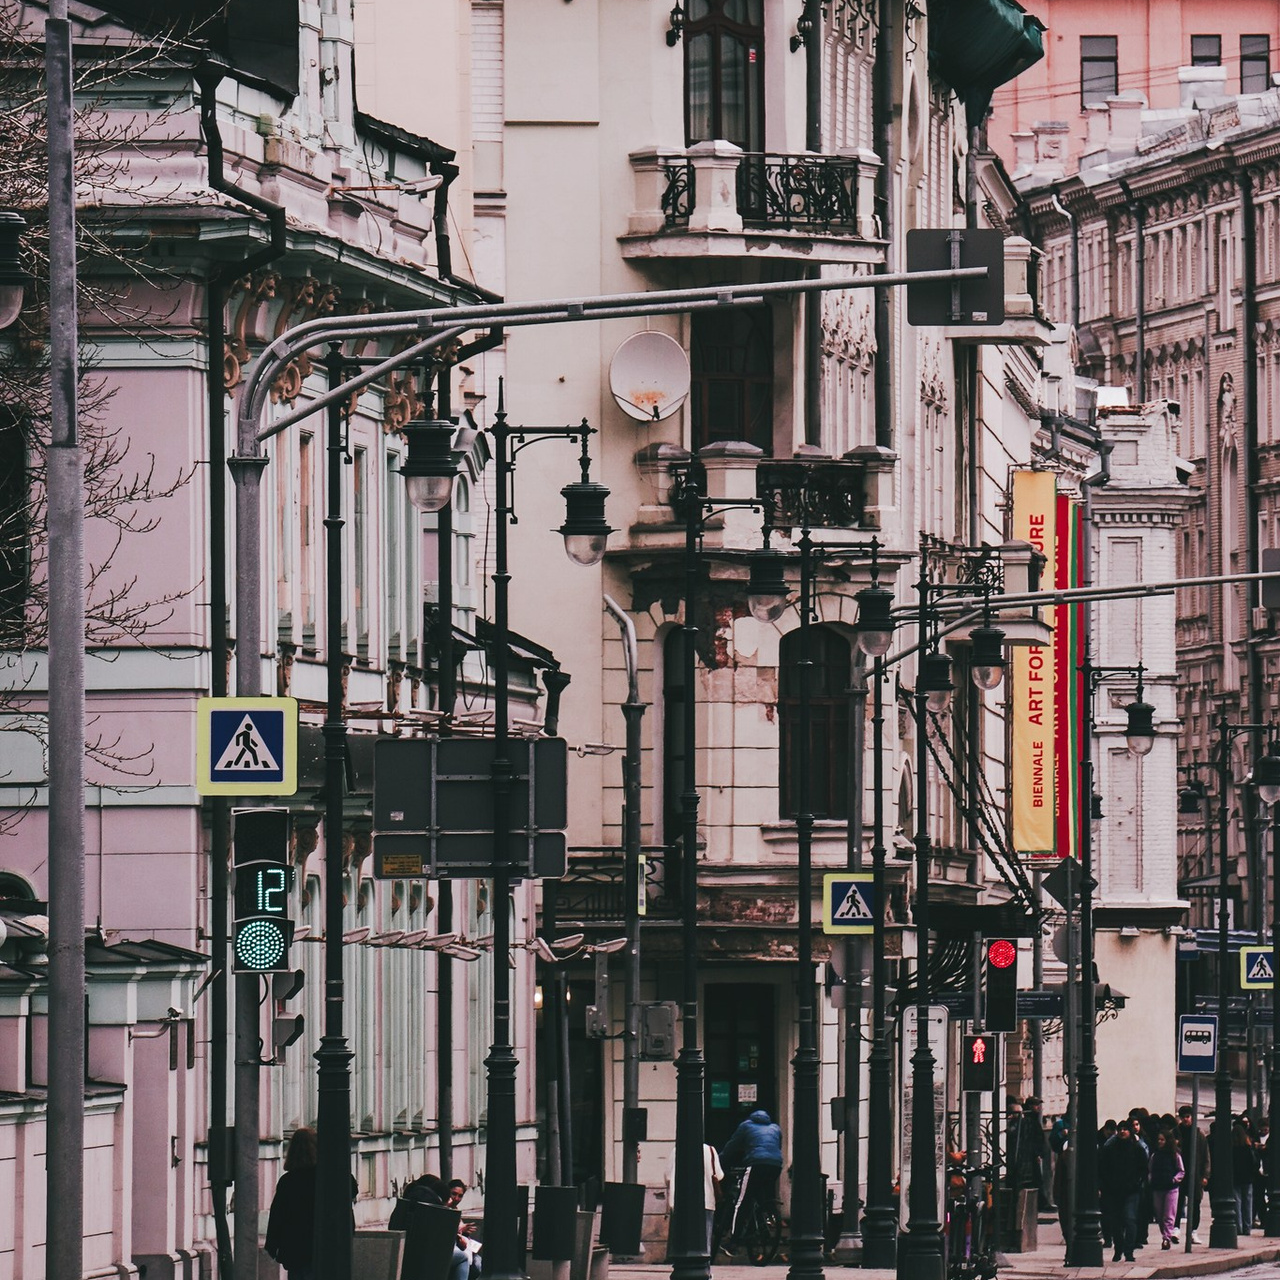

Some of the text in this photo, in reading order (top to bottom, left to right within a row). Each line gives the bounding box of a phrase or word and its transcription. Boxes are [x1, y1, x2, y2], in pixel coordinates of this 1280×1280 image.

[1028, 687, 1043, 726] ART
[1032, 741, 1043, 808] BIENNALE
[257, 868, 285, 912] 12
